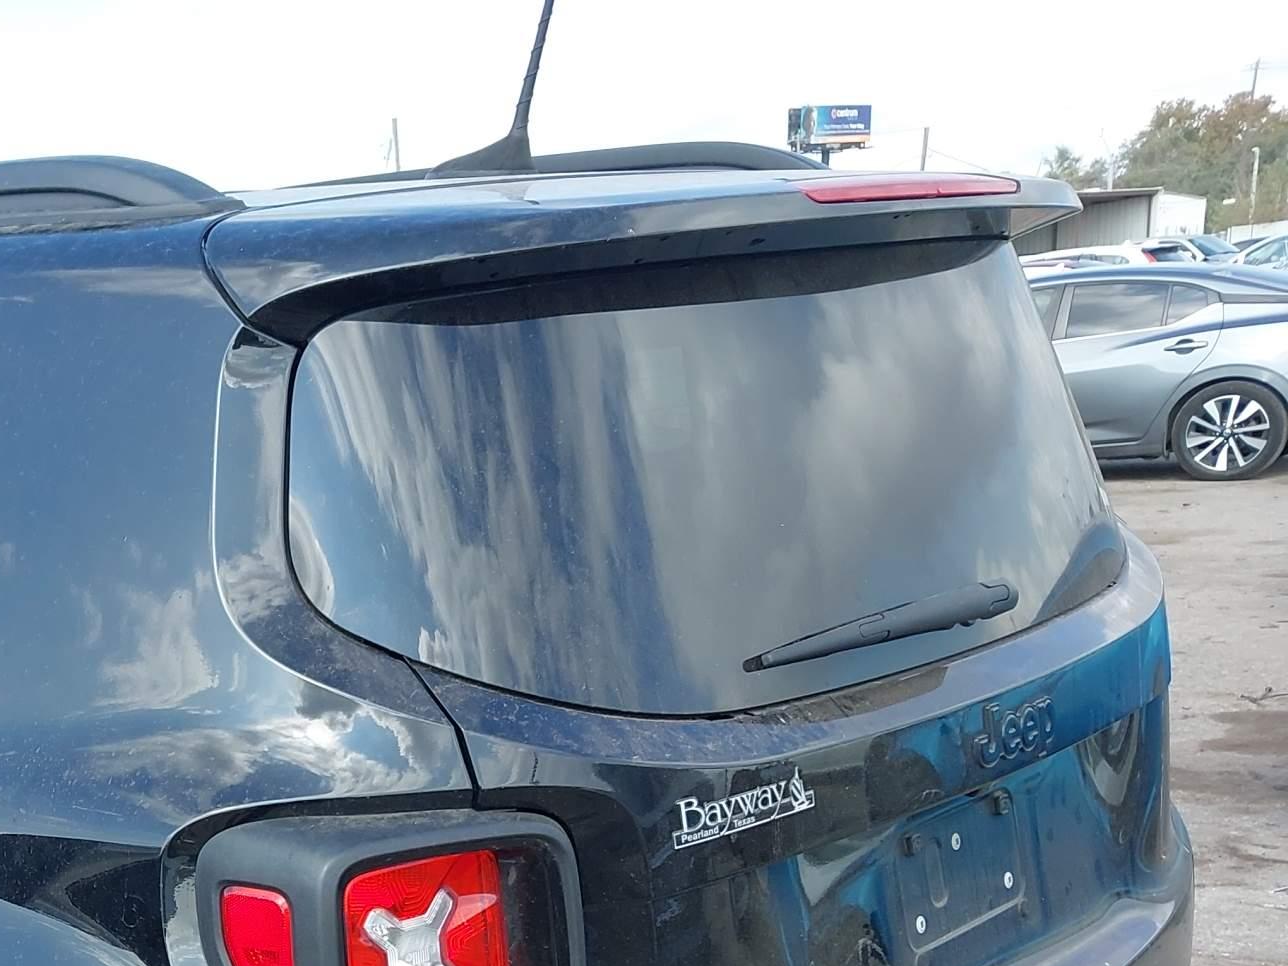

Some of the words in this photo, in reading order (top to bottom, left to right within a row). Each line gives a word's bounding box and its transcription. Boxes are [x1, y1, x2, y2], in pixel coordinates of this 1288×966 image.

[974, 696, 1054, 768] Jeep
[675, 780, 788, 837] Bayway
[732, 816, 756, 829] Texas
[680, 826, 720, 844] Pearland
